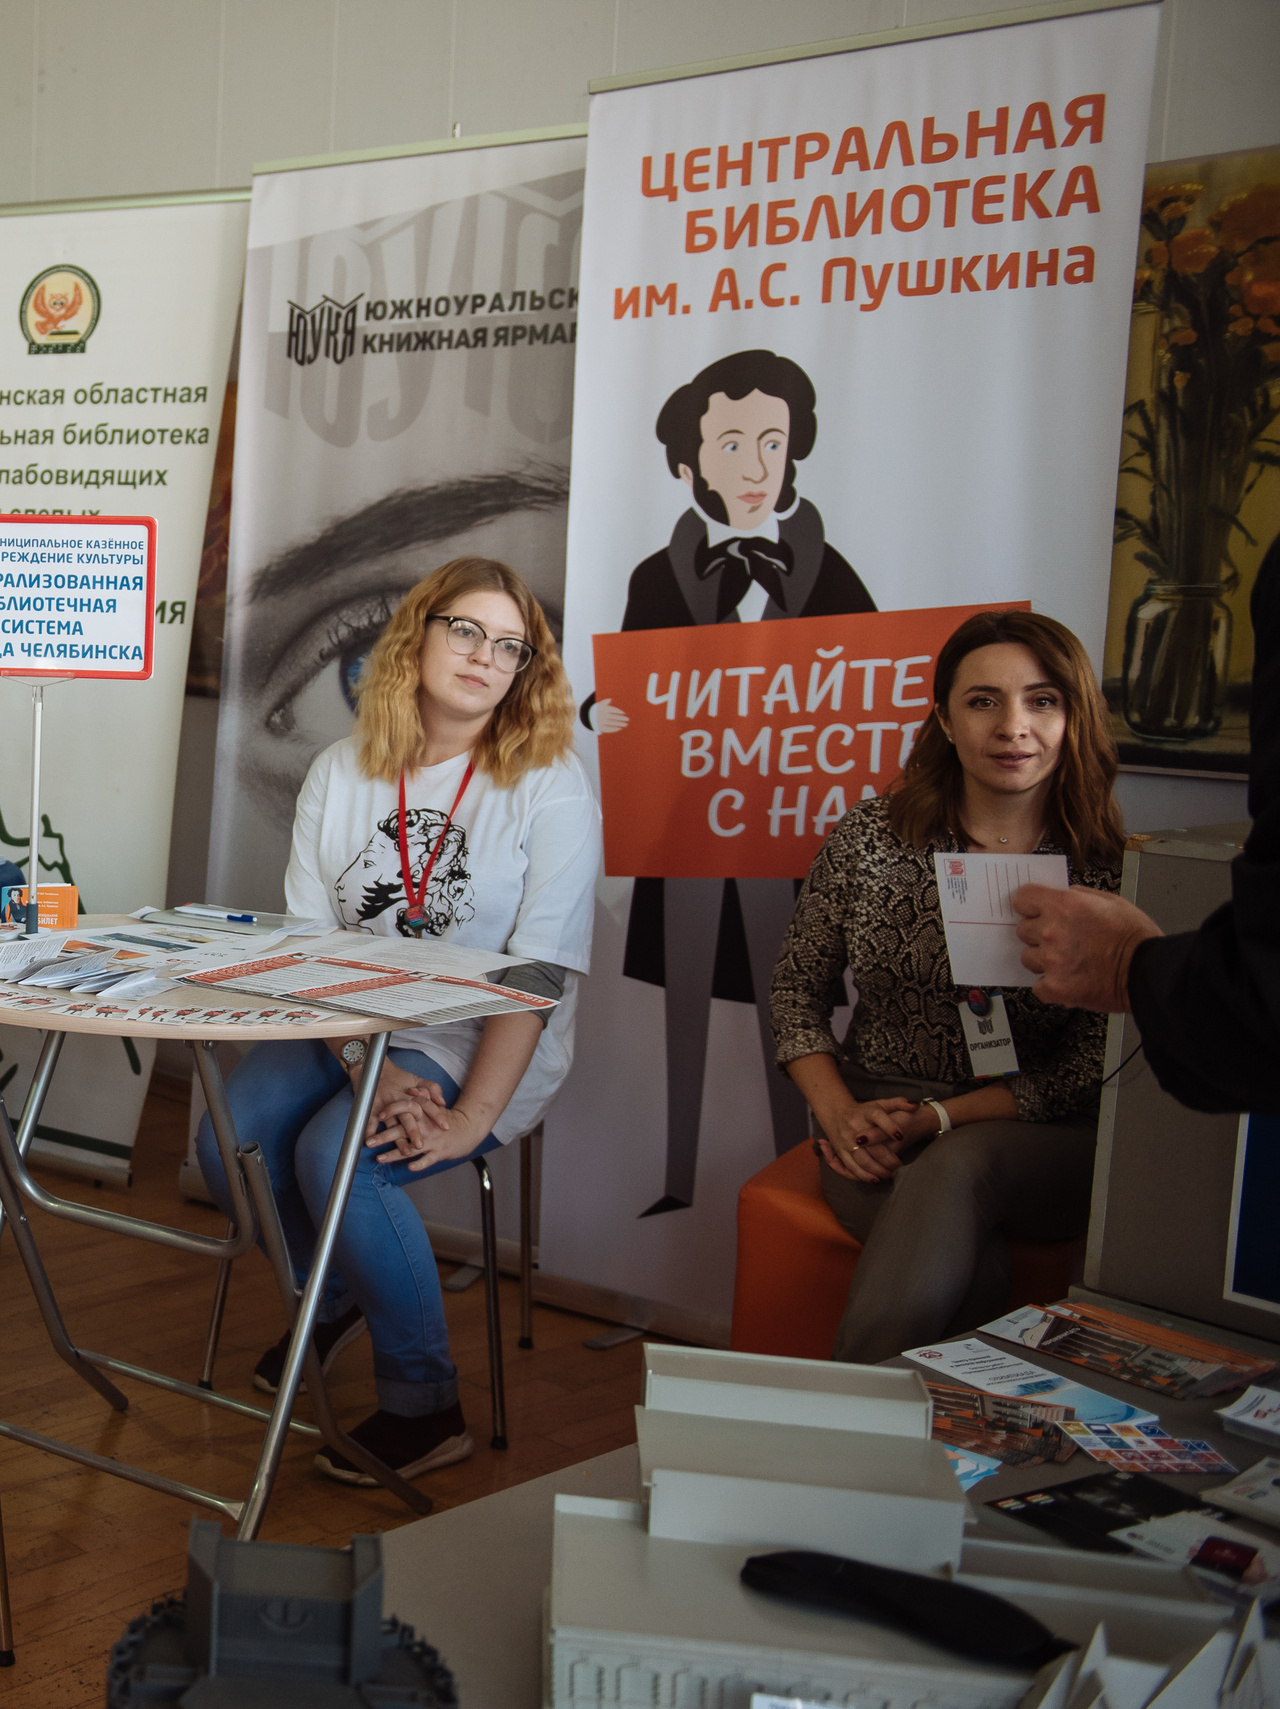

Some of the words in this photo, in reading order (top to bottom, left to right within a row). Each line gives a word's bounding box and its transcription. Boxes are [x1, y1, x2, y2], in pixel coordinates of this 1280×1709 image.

[641, 93, 1106, 202] ЦЕНТРАЛЬНАЯ
[685, 165, 1100, 254] БИБЛИОТЕКА
[613, 283, 691, 320] им.
[708, 262, 800, 313] А.С.
[821, 245, 1096, 312] Пушкина
[362, 327, 488, 354] КНИЖНАЯ
[73, 382, 208, 405] областная
[63, 422, 210, 446] библиотека
[86, 537, 144, 550] КАЗЁННОЕ
[76, 553, 144, 566] КУЛЬТУРЫ
[1, 619, 84, 636] СИСТЕМА
[21, 643, 144, 661] ЧЕЛЯБИНСКА
[646, 645, 932, 721] ЧИТАЙТЕ
[708, 788, 746, 838] С
[970, 1038, 1012, 1051] ОРГАНИЗАТОР
